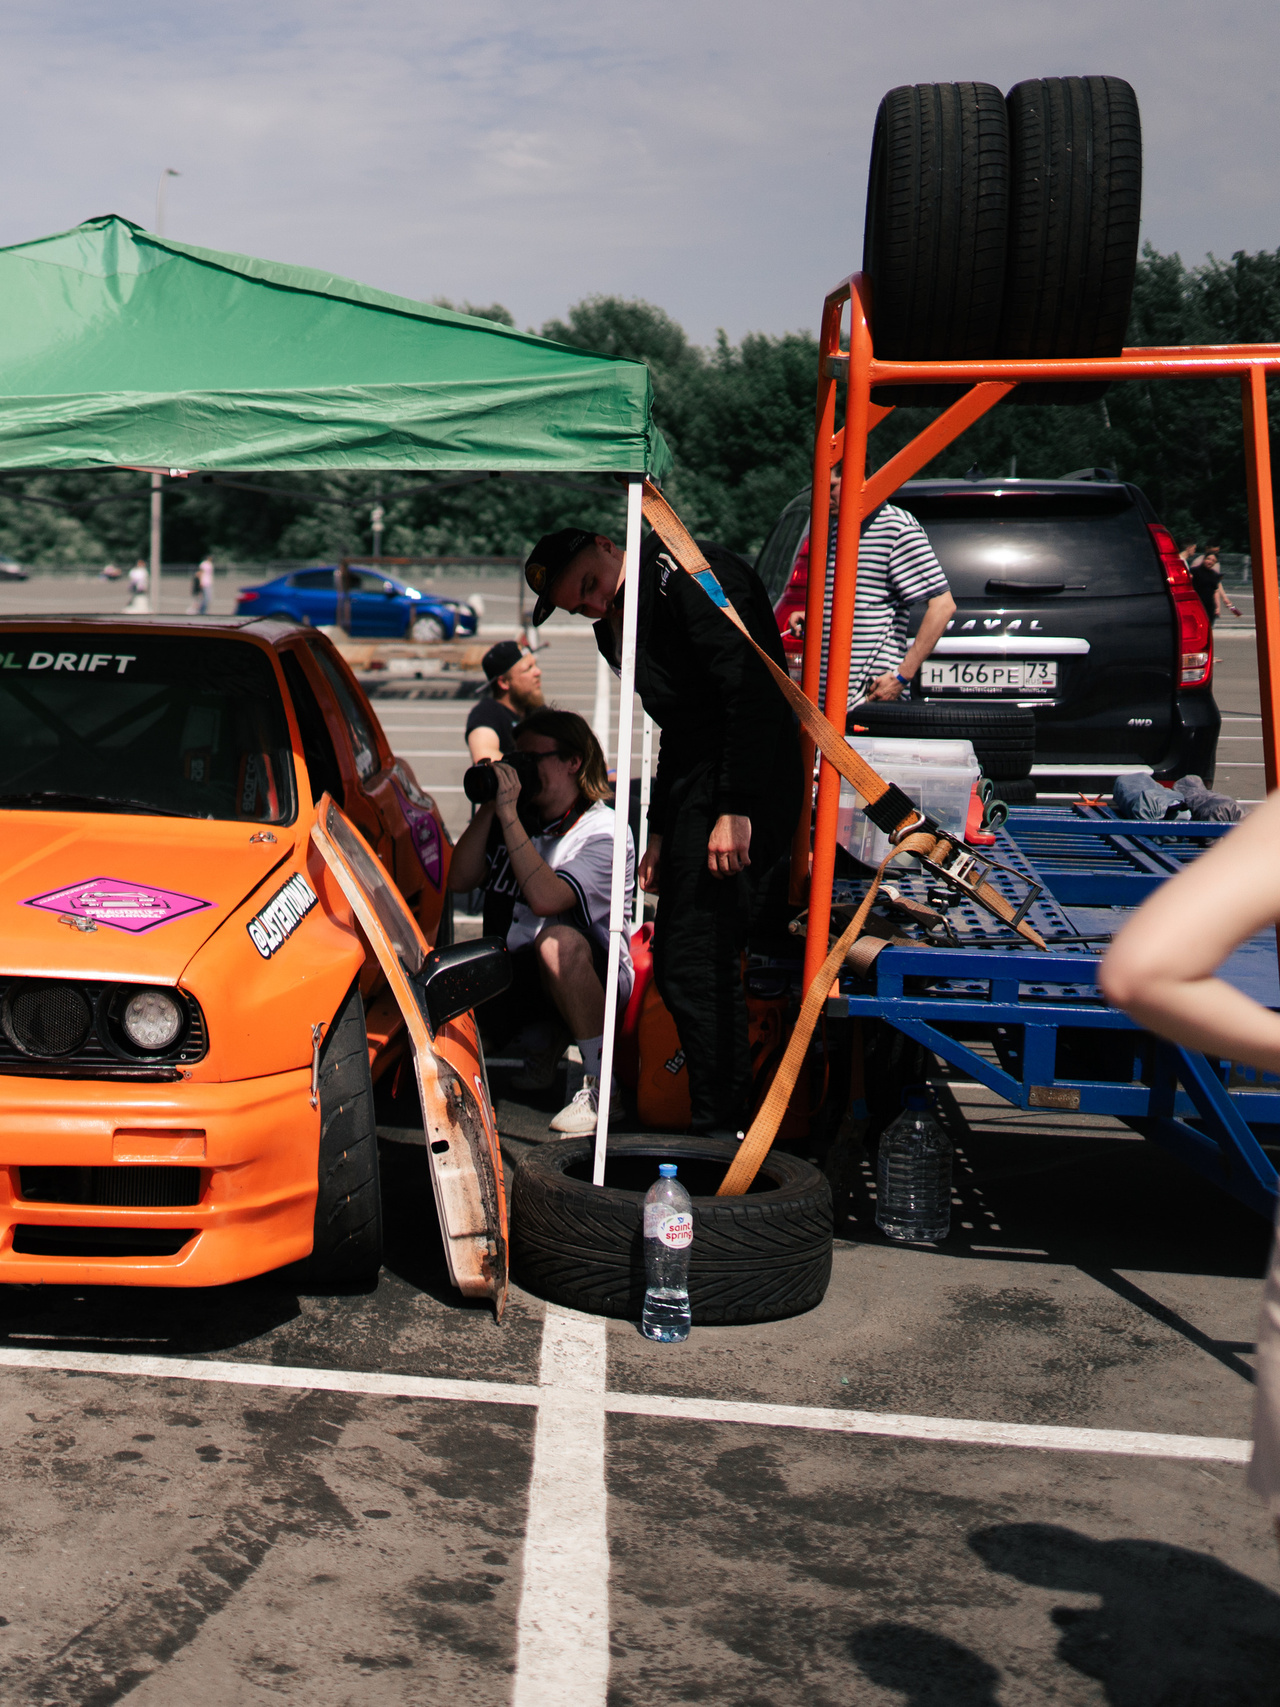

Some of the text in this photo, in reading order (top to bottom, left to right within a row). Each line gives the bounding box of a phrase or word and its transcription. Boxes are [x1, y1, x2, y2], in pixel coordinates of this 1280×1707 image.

[28, 652, 136, 674] DRIFT
[1027, 662, 1048, 679] 73
[1127, 718, 1153, 727] 4WD
[669, 1222, 691, 1232] saint
